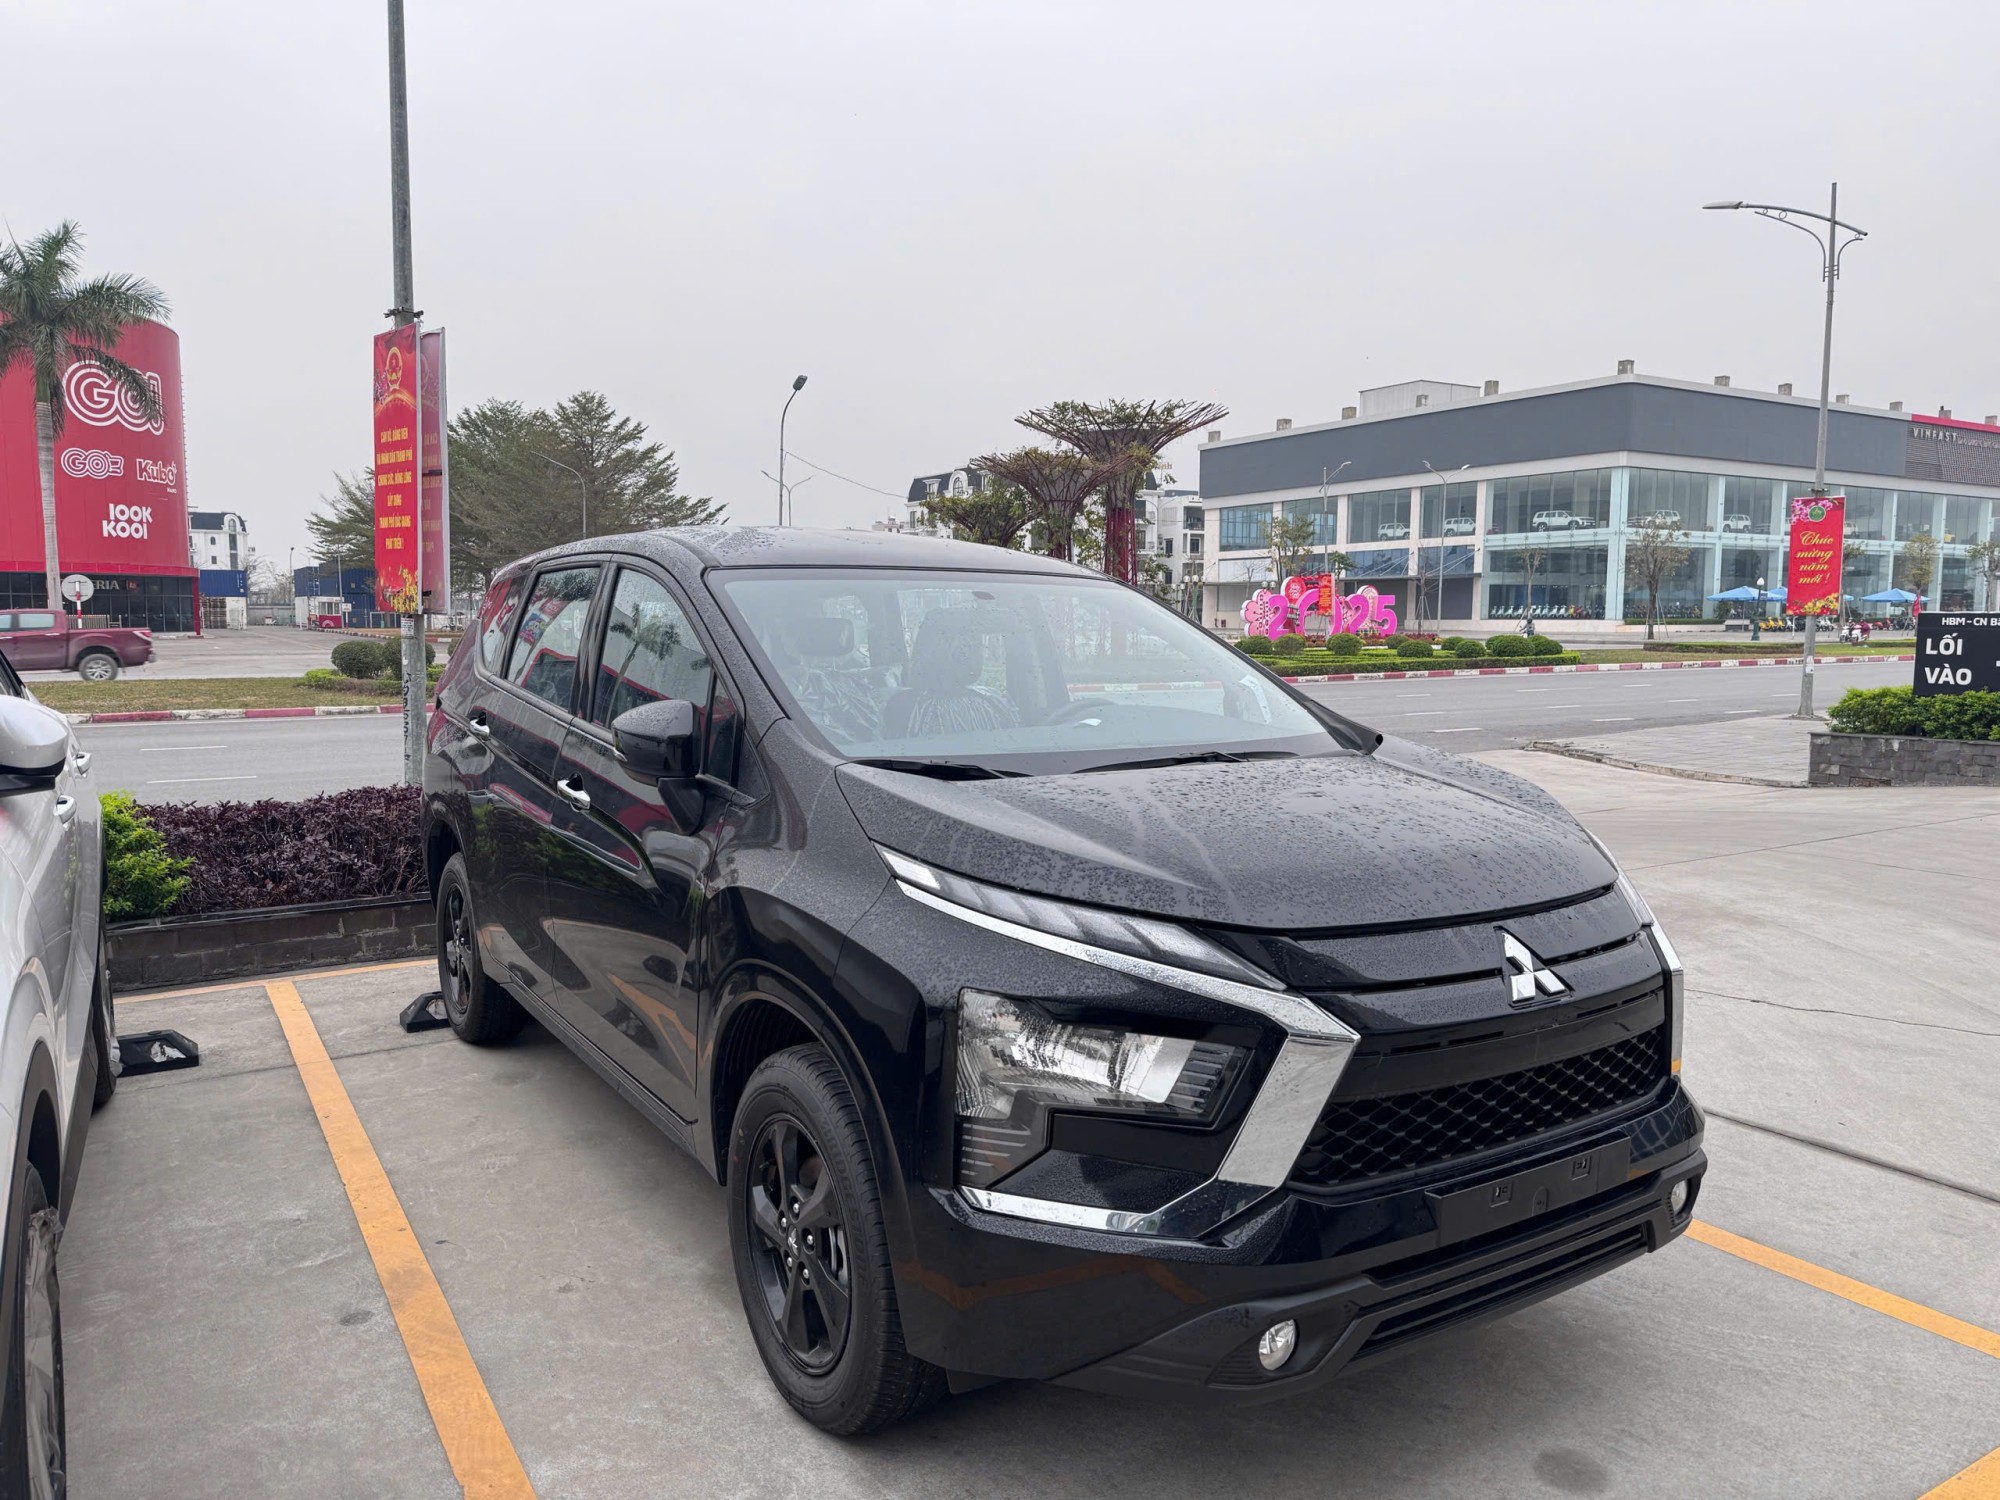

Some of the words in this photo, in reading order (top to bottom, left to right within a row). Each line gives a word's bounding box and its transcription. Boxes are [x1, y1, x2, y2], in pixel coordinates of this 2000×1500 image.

[1913, 428, 1958, 442] VINFAST
[1800, 530, 1834, 546] Chúc
[1796, 548, 1833, 563] mừng
[1799, 563, 1829, 572] năm
[1798, 573, 1823, 584] mới
[1266, 589, 1397, 641] 2025
[1942, 617, 1966, 626] HBM
[1973, 617, 1988, 626] CN
[1925, 632, 1963, 656] LỐI
[1924, 663, 1972, 686] VÀO
